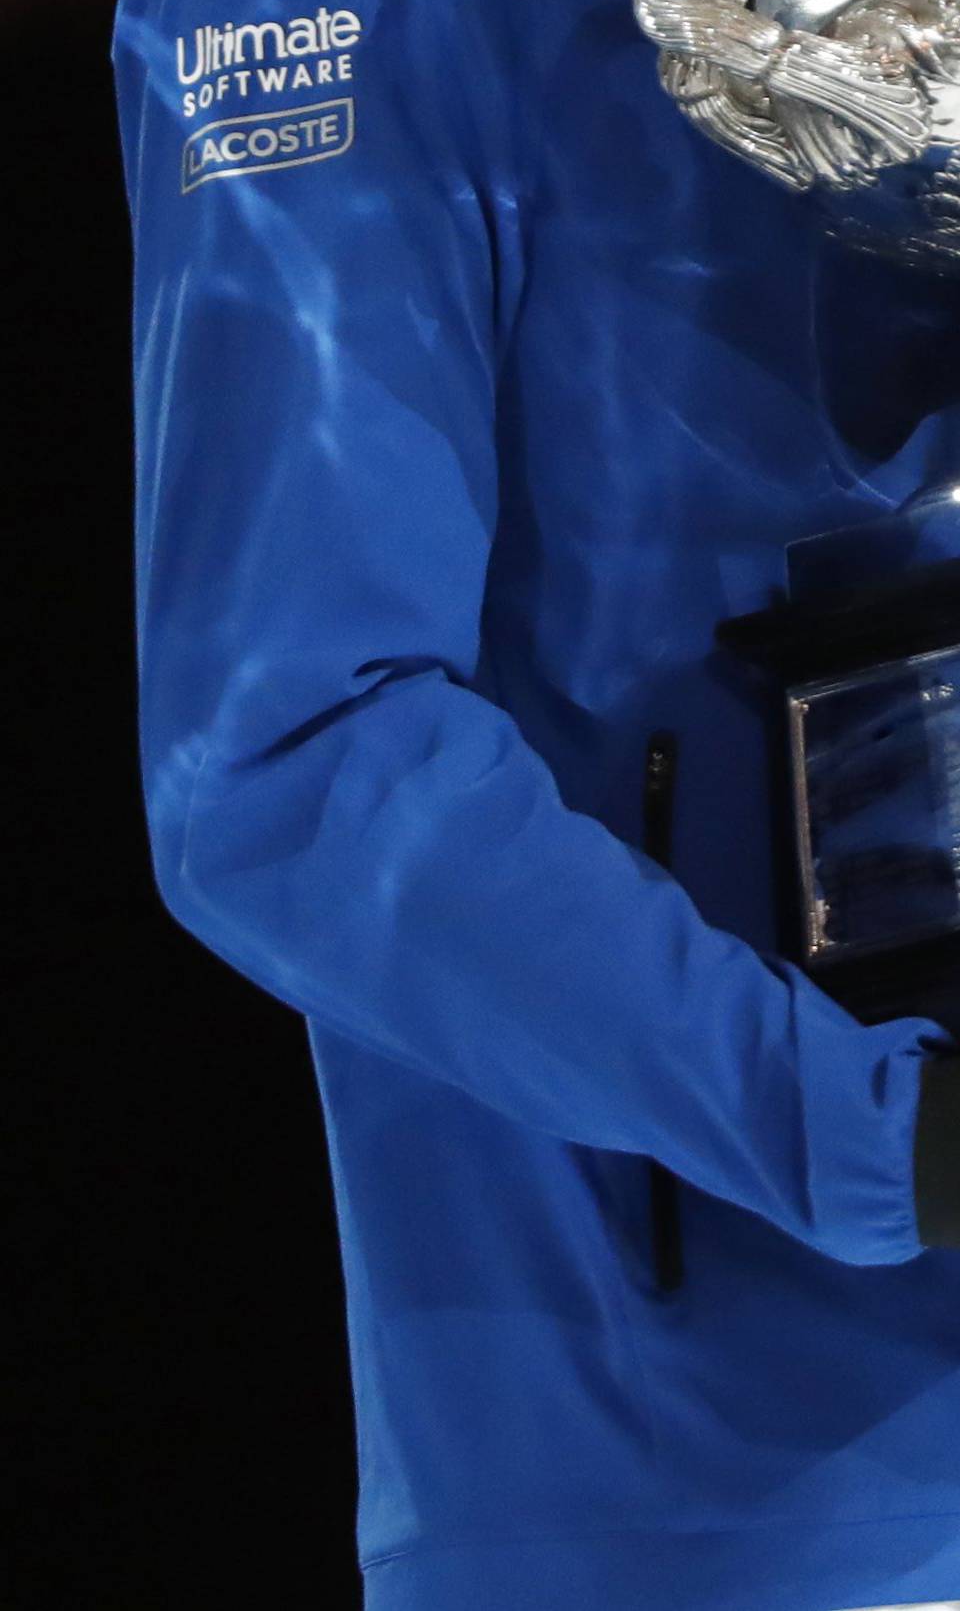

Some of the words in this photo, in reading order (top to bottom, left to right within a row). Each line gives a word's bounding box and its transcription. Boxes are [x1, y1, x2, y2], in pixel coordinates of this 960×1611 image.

[176, 7, 361, 85] Ultimate
[183, 53, 353, 117] SOFTWARE
[190, 114, 340, 174] LACOSTE
